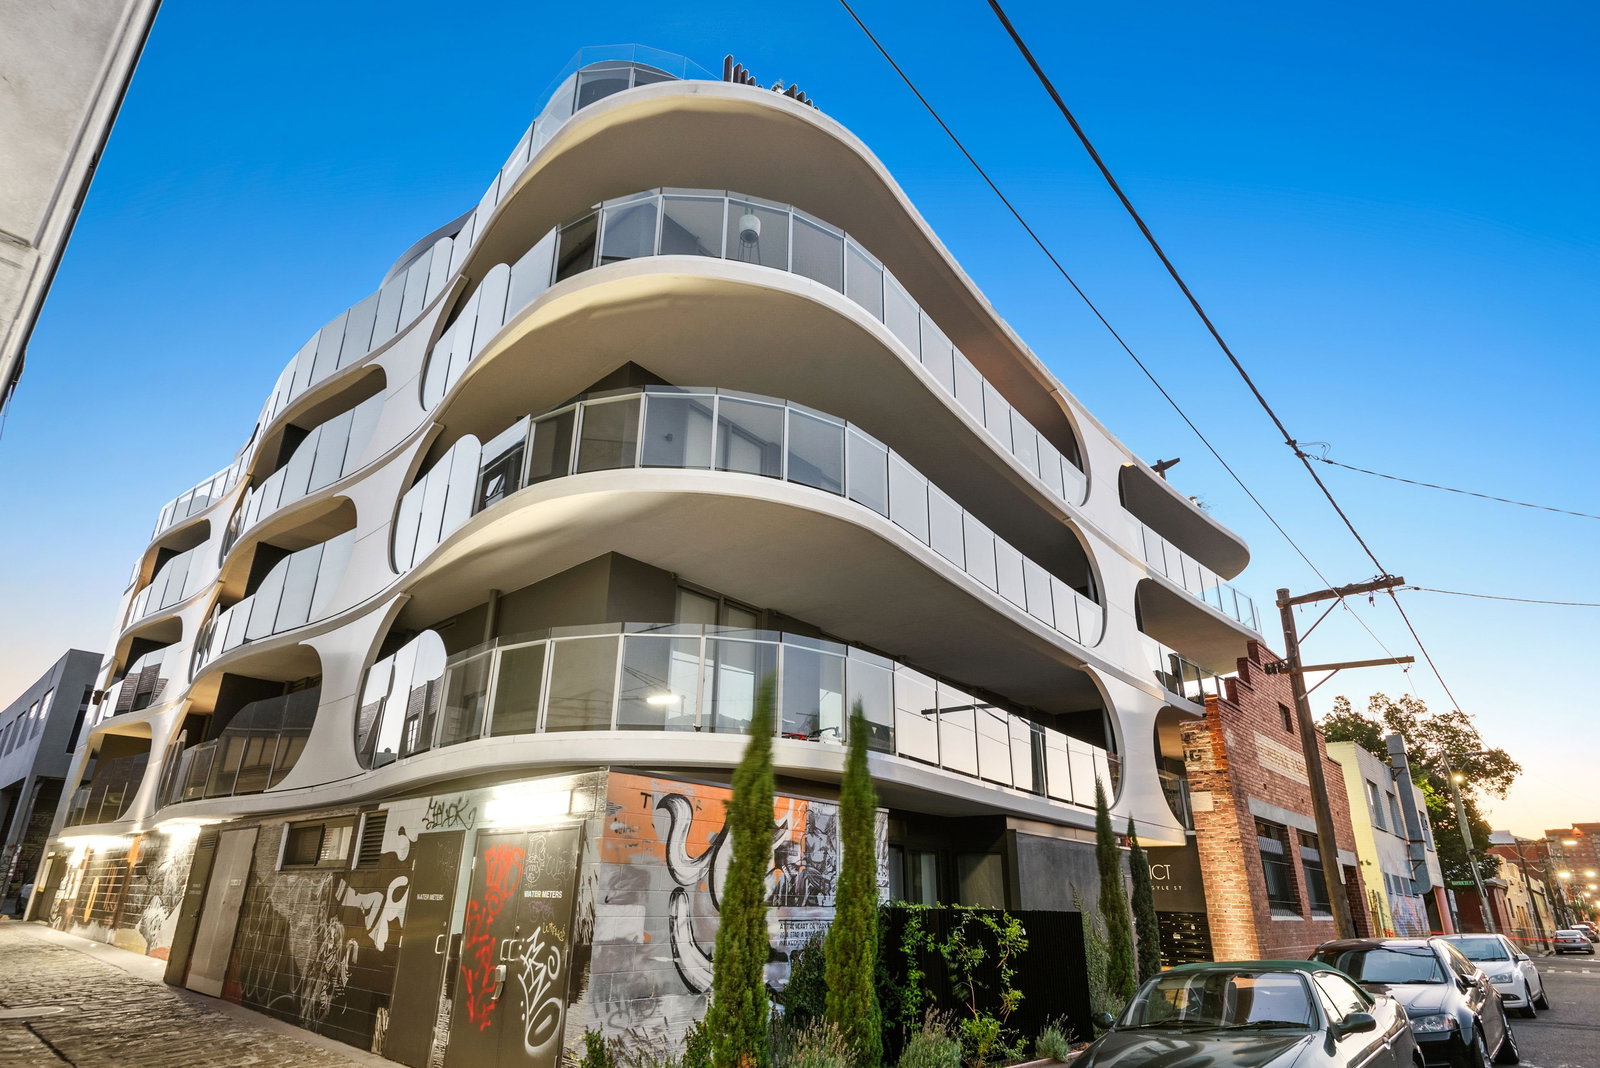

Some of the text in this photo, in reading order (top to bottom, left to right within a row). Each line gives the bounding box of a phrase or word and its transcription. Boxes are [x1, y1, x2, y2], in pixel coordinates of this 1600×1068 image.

[416, 893, 444, 901] WATER METERS
[524, 890, 563, 899] WATER METERS
[795, 922, 808, 930] HEART
